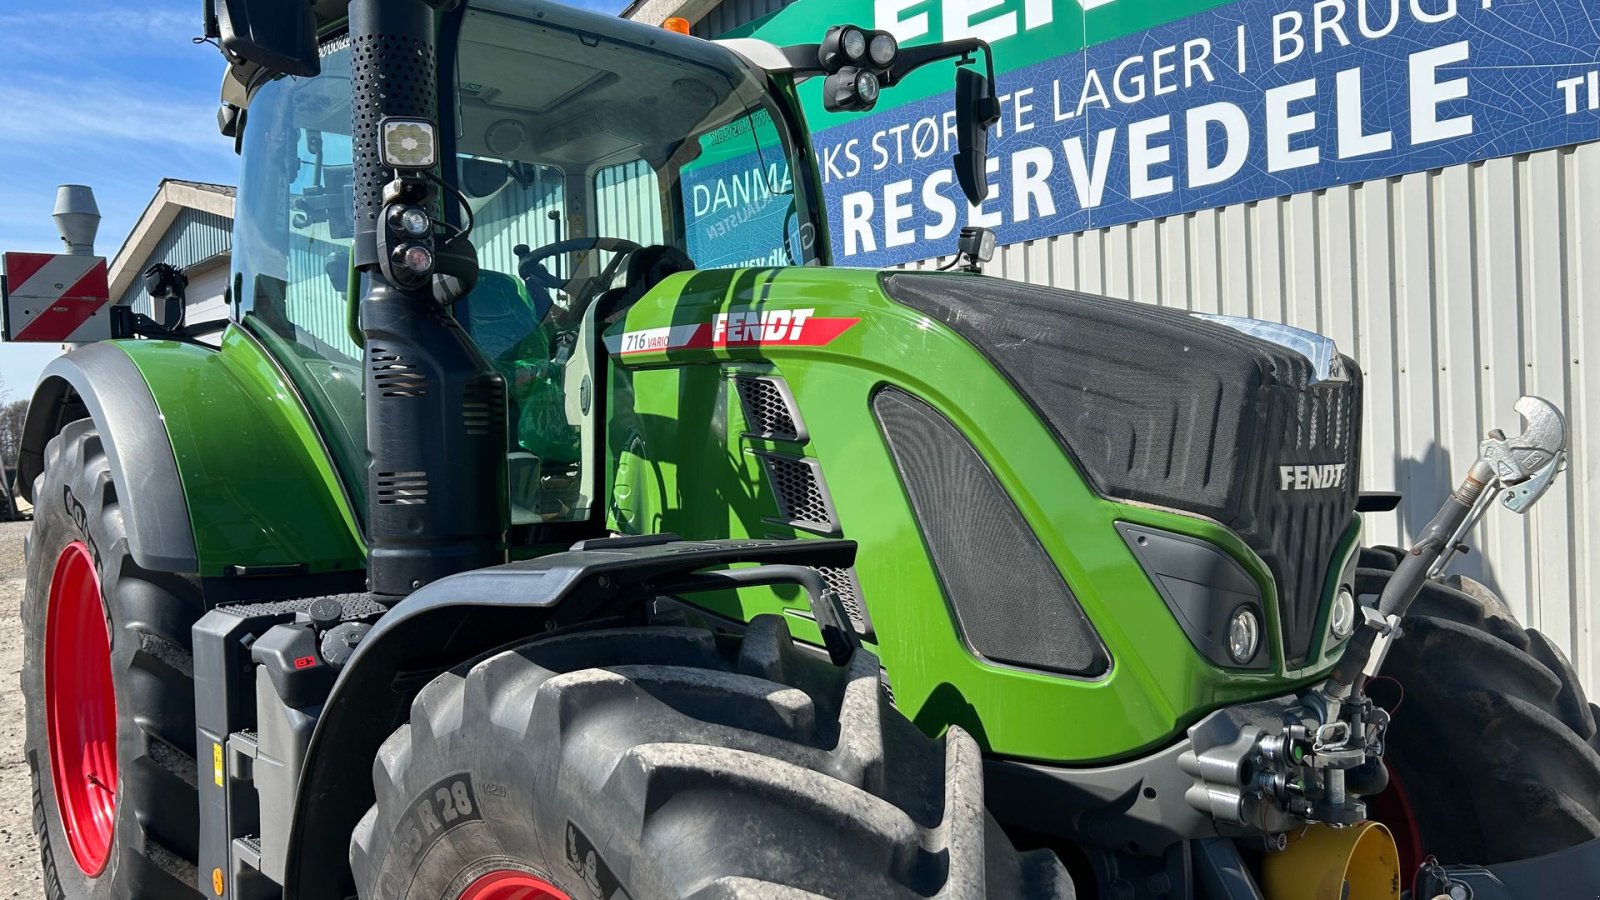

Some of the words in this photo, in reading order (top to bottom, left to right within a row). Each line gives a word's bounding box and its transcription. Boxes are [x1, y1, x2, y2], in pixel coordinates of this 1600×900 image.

[872, 88, 1034, 170] STØRTE
[1053, 38, 1215, 122] LAGER
[1237, 25, 1246, 73] I
[842, 40, 1474, 256] RESERVEDELE
[626, 333, 646, 351] 716
[648, 335, 670, 348] VARIO
[711, 308, 815, 343] FENDT
[1279, 463, 1346, 491] FENDT
[418, 799, 441, 836] R
[435, 780, 473, 822] 28
